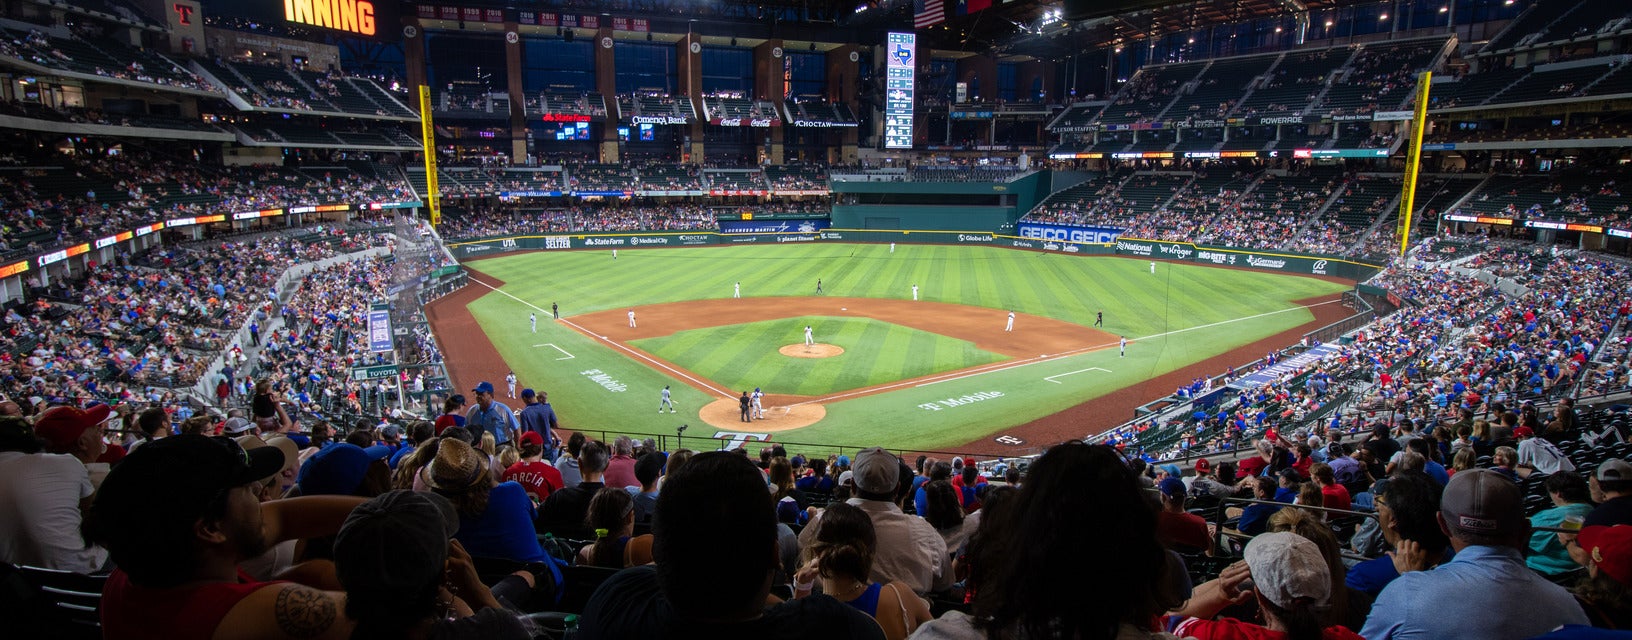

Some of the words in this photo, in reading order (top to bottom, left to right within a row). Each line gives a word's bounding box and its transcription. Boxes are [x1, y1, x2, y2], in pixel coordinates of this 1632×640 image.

[173, 3, 193, 26] T
[283, 0, 376, 36] INNING
[405, 27, 415, 36] 42
[507, 34, 517, 43] 34
[603, 38, 613, 47] 26
[554, 114, 571, 122] State
[571, 114, 591, 122] Farm
[669, 116, 687, 124] Bank
[1260, 116, 1303, 125] POWERADE
[983, 234, 993, 242] Life
[1020, 226, 1068, 242] GEICO
[502, 239, 516, 247] UTA
[546, 238, 571, 249] SELTZER
[1124, 243, 1152, 252] National
[1170, 244, 1193, 259] Kroger
[1199, 251, 1210, 259] BIG
[1211, 253, 1227, 261] BITE
[1257, 258, 1286, 266] Germania
[588, 373, 627, 392] Mobile
[938, 392, 1004, 407] Mobile
[507, 472, 544, 487] GARCÍA
